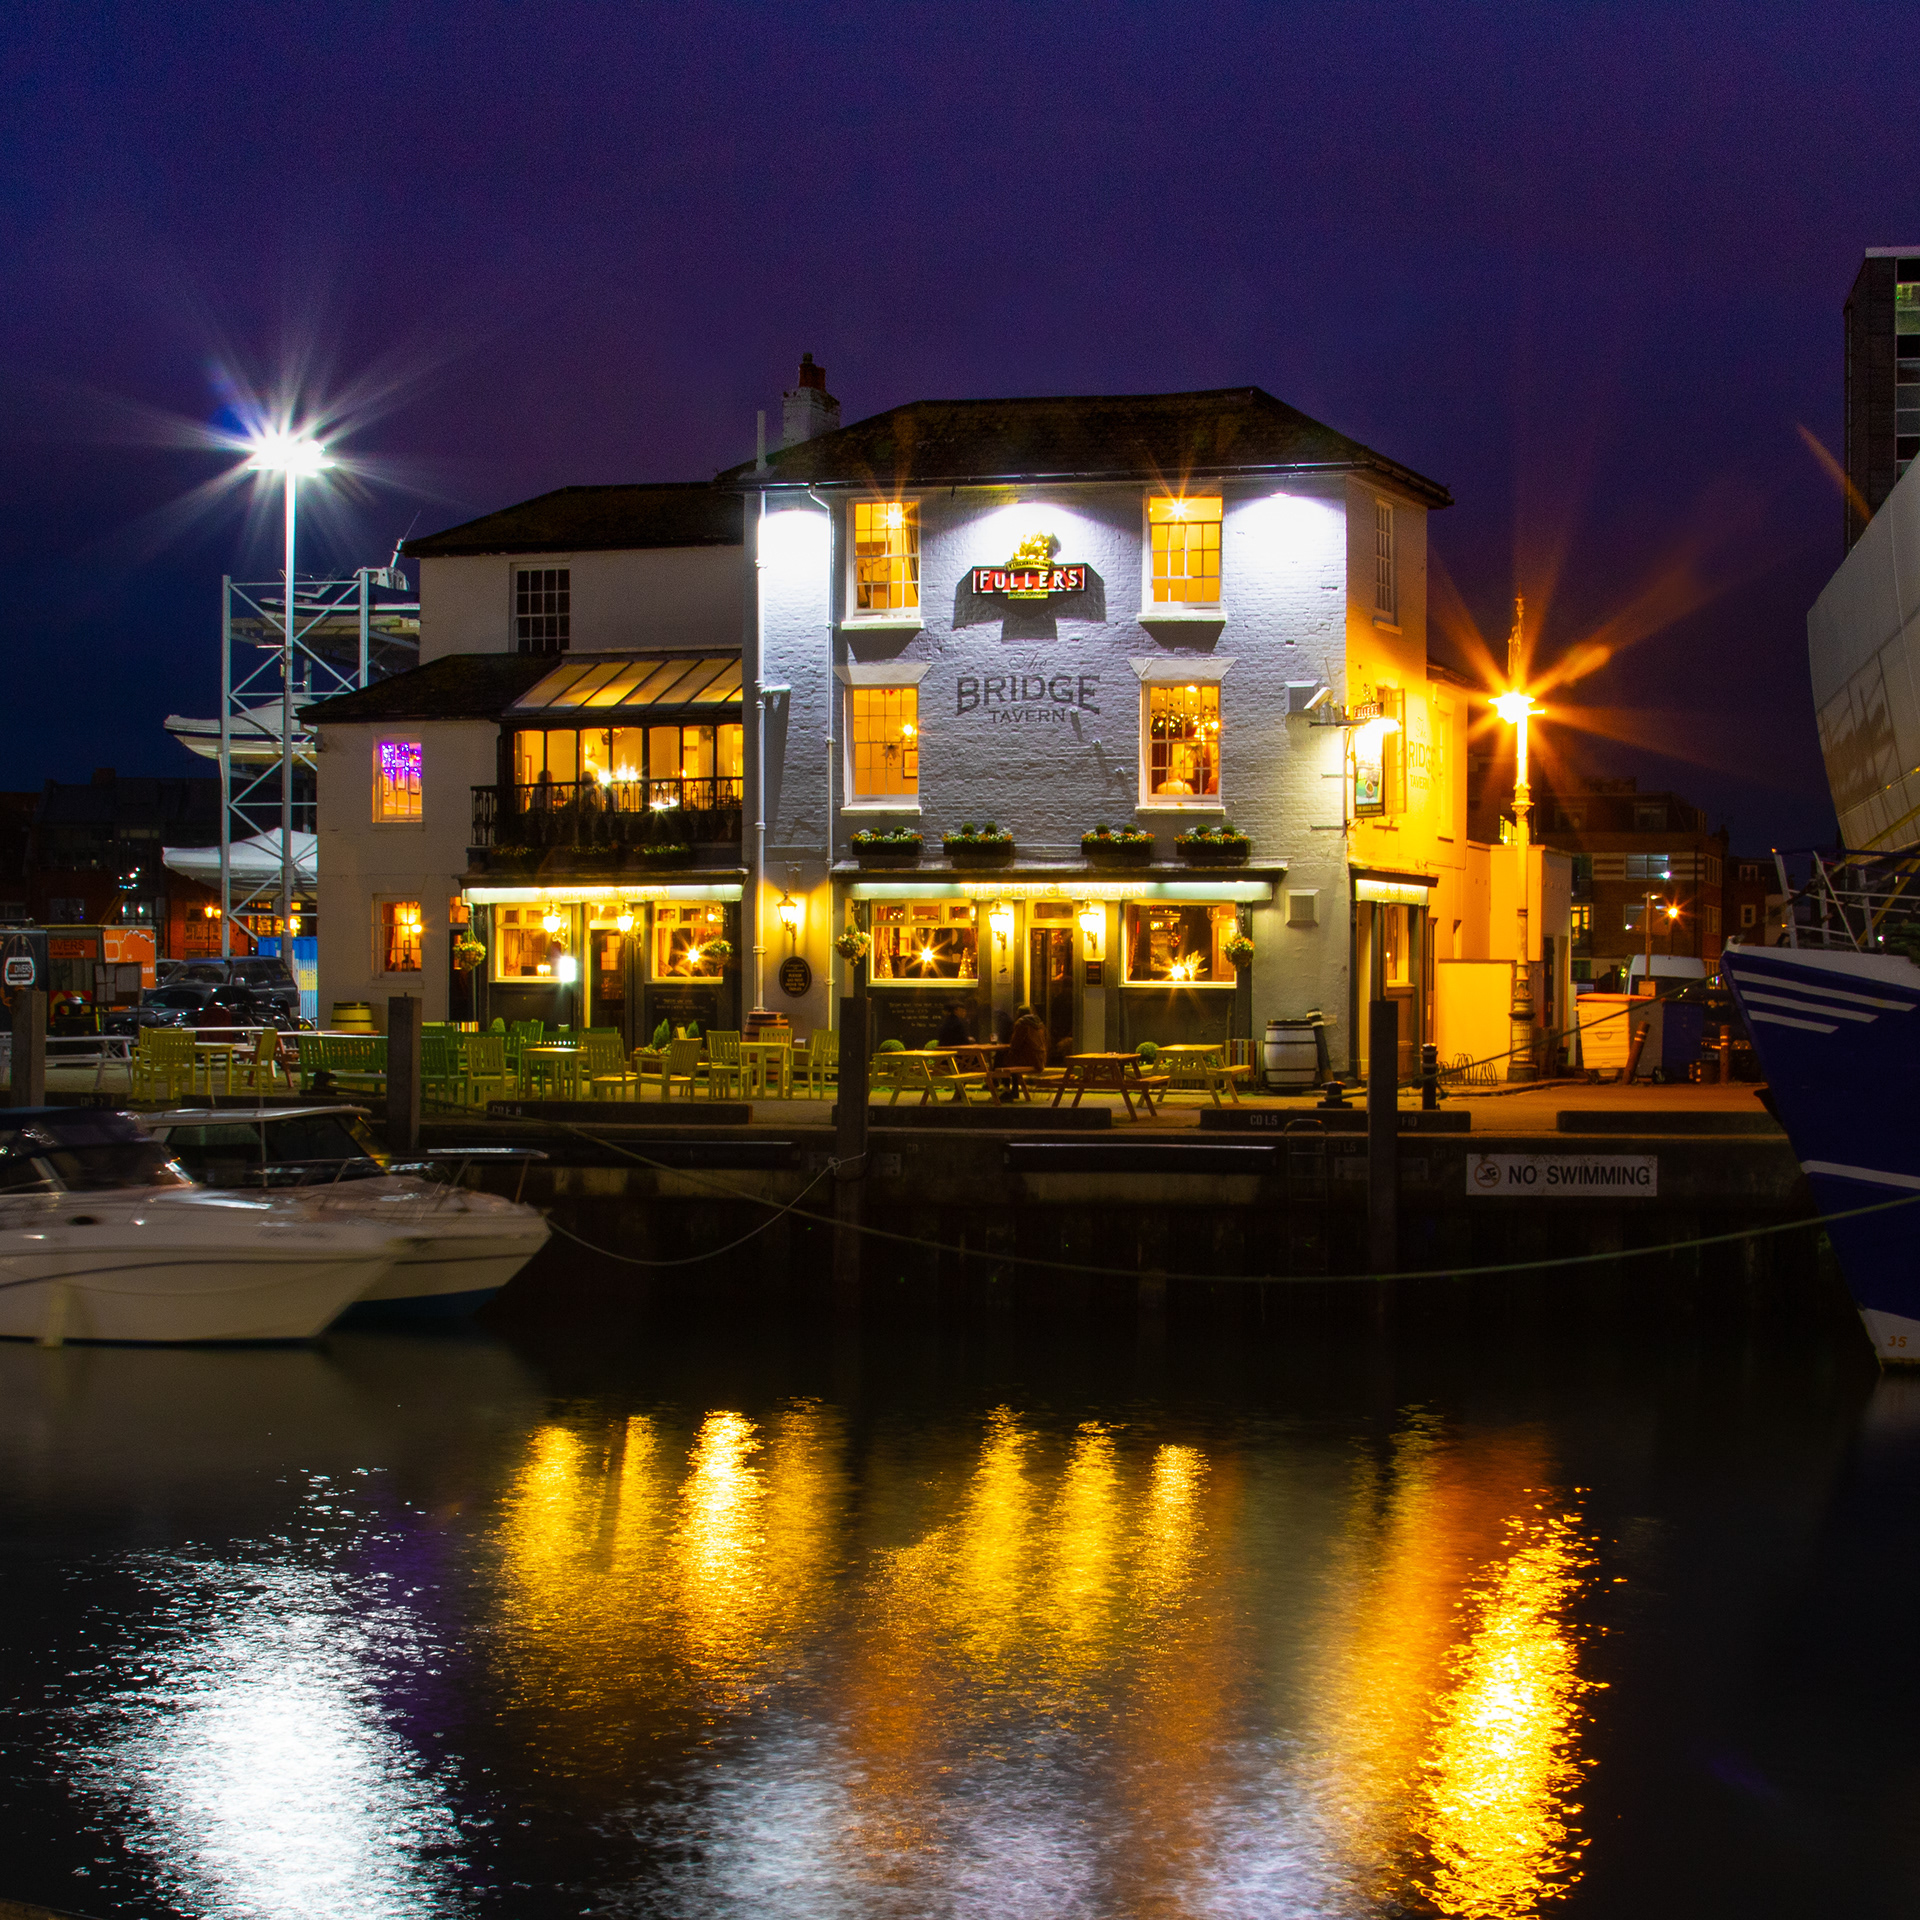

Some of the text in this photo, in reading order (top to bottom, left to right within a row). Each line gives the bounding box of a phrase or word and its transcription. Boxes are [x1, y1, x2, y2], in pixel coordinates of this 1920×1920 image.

[979, 566, 1078, 589] FULLER'S
[1008, 651, 1048, 670] The
[956, 674, 1101, 716] BRIDGE
[987, 708, 1067, 724] TAVERN
[616, 886, 670, 900] TAVERN
[960, 885, 1147, 898] THE BRIDGE TAVERN
[1508, 1165, 1651, 1186] NO SWIMMING
